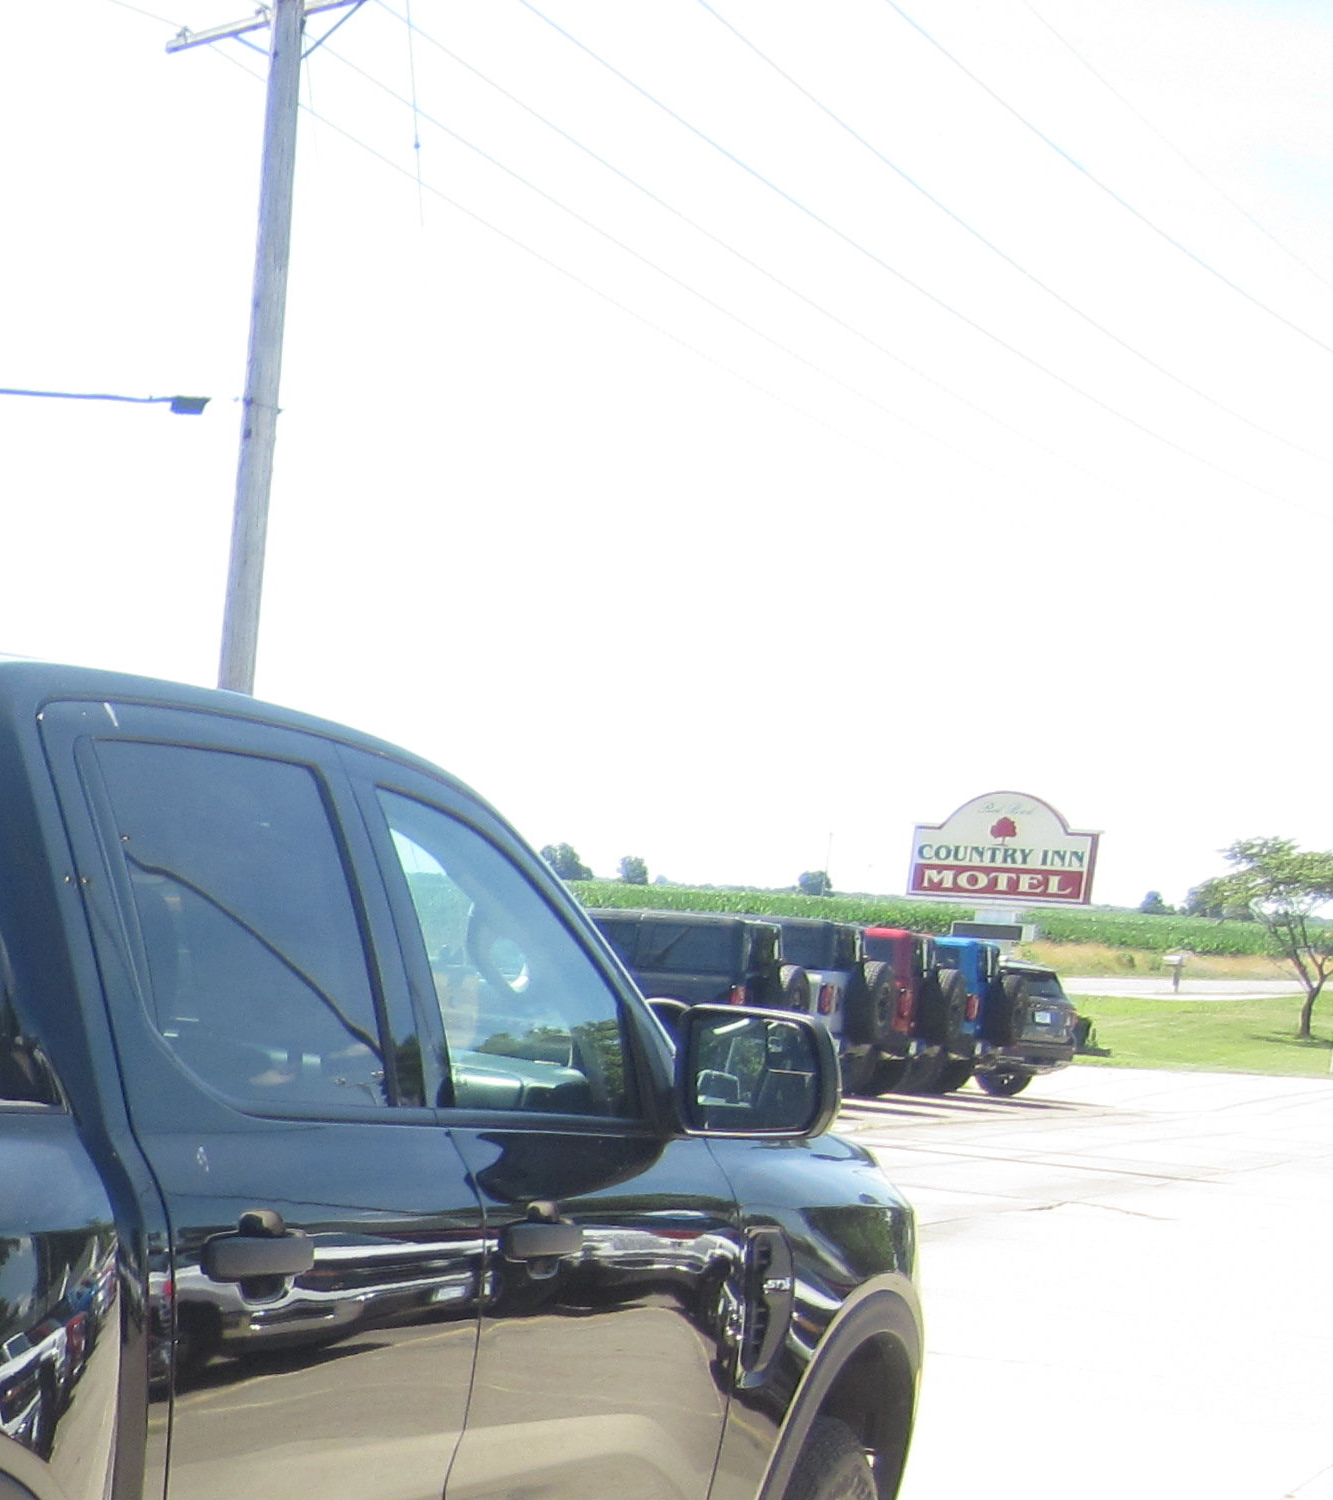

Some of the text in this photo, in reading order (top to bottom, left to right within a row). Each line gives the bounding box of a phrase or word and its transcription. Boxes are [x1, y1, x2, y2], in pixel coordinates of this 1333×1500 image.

[917, 843, 1085, 868] COUNTRY INN
[921, 868, 1074, 895] MOTEL
